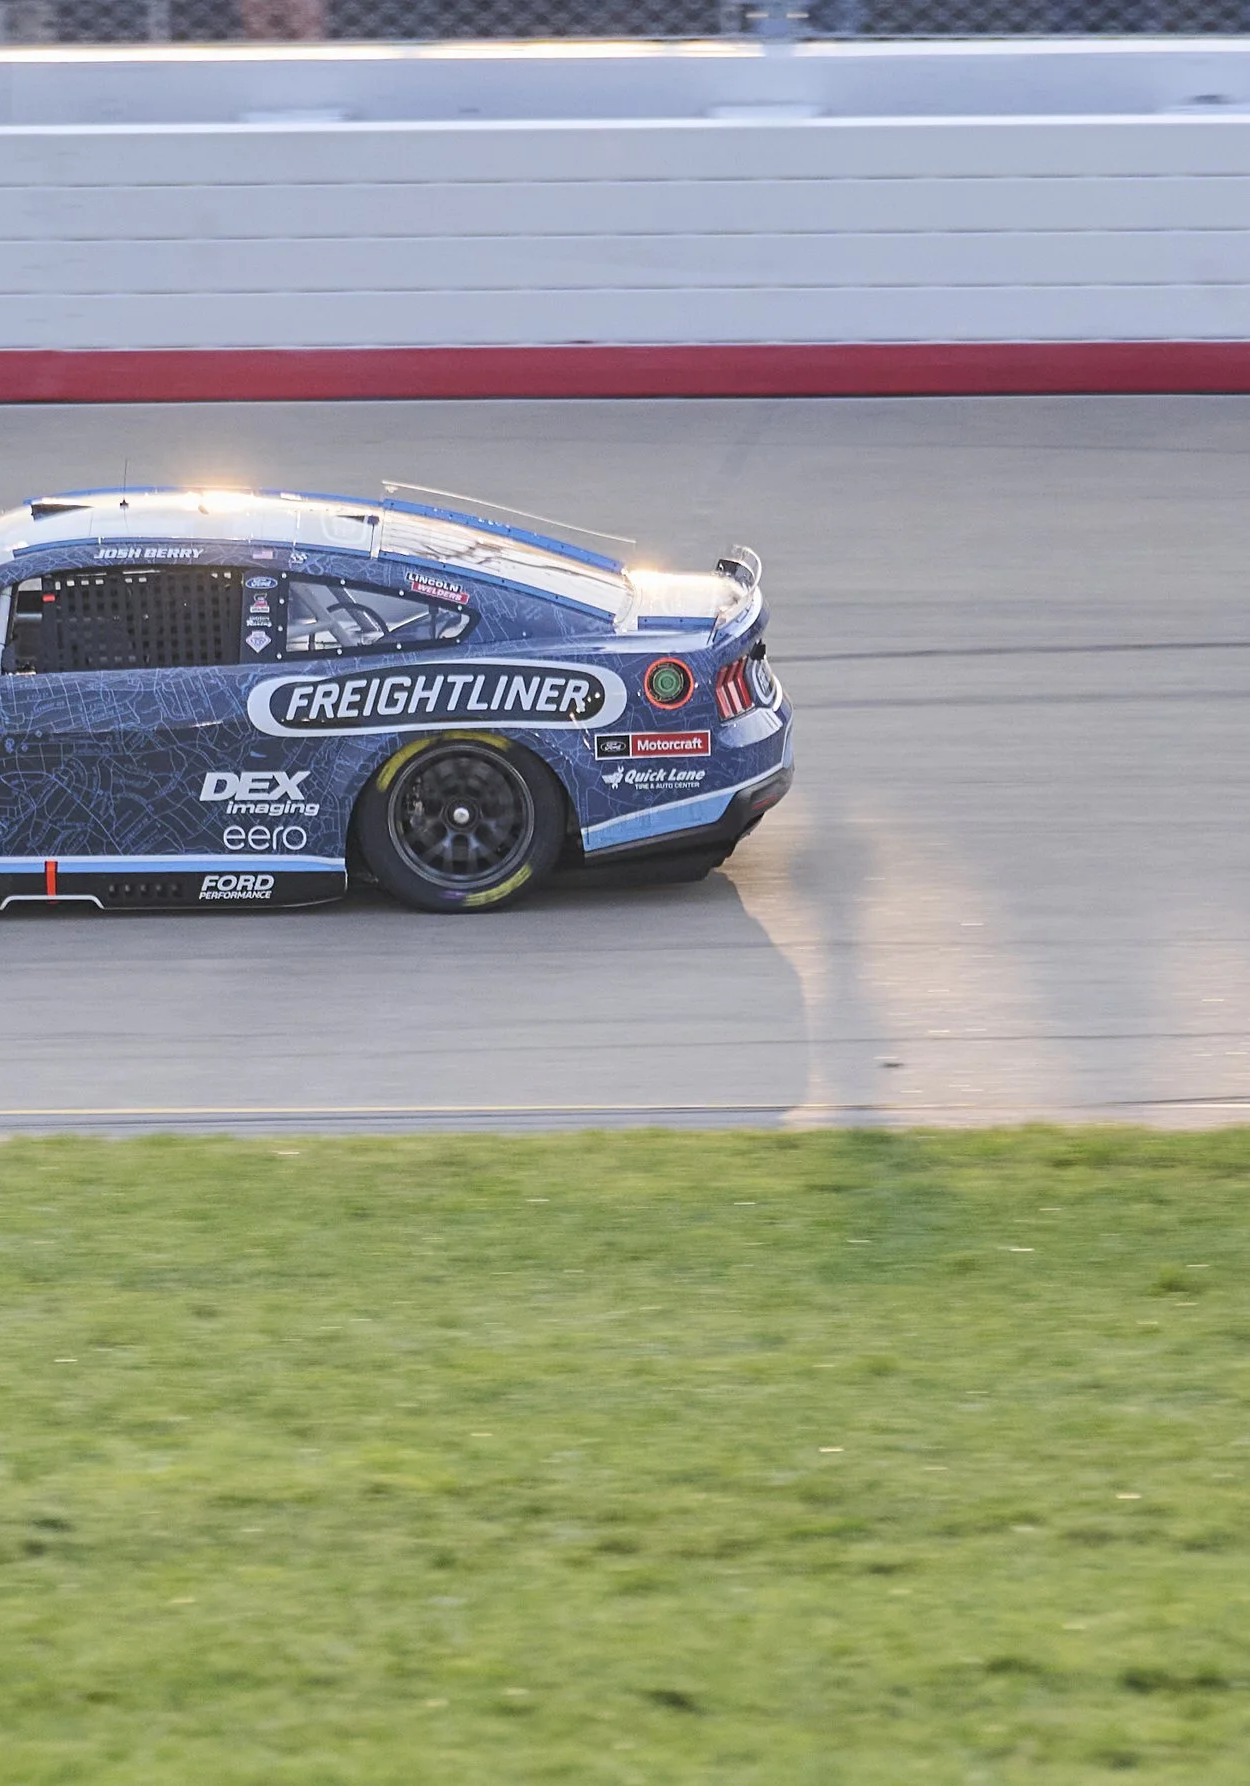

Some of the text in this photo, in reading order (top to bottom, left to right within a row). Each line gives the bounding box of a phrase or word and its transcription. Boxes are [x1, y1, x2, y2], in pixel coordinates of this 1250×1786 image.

[94, 548, 204, 559] JOSH BERRY
[408, 573, 460, 592] LINCOLN
[285, 674, 591, 721] FREIGHTLINER
[637, 738, 703, 751] Motorcraft
[625, 768, 706, 784] Quick Lane
[200, 771, 312, 801] DEX
[226, 801, 320, 816] imaging
[223, 825, 307, 850] eero
[202, 875, 275, 891] FORD
[199, 890, 272, 900] PERFORMANCE
